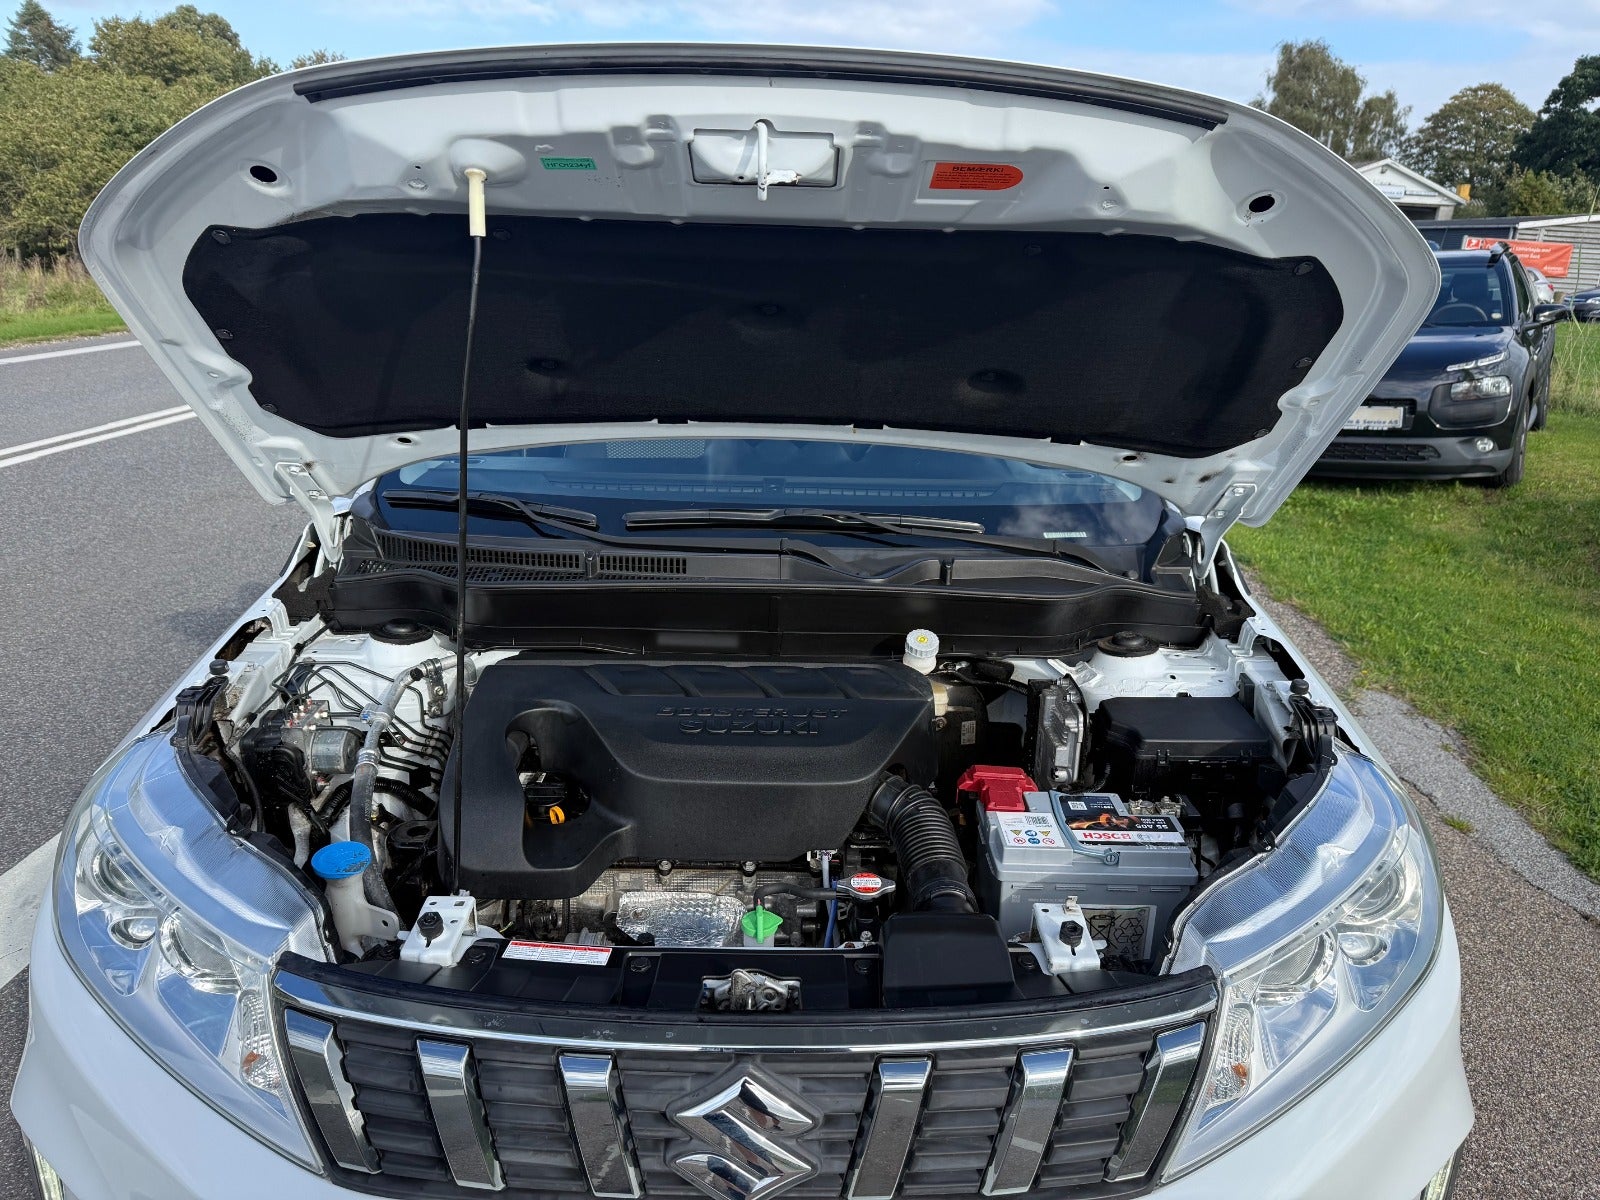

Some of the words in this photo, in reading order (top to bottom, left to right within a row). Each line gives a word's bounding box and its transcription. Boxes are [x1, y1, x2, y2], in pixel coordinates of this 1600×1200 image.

[656, 707, 848, 718] BOOSTERJET
[679, 719, 819, 734] SUZUKI
[1082, 832, 1132, 840] BOSCH
